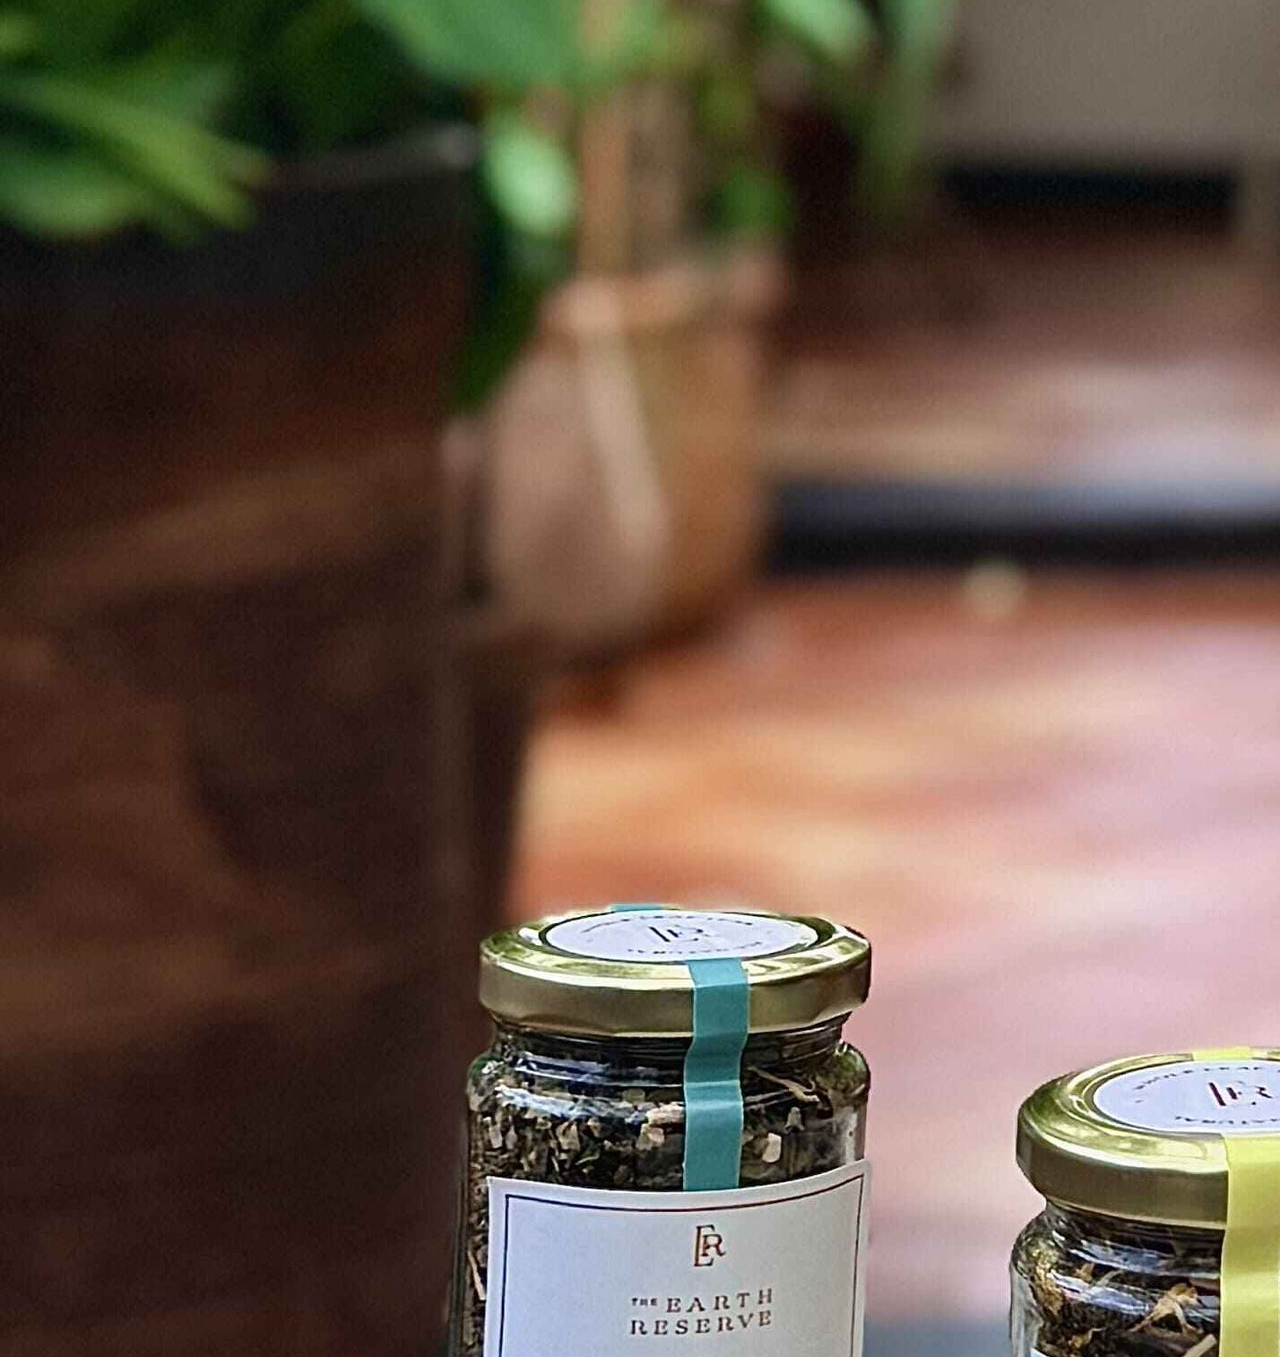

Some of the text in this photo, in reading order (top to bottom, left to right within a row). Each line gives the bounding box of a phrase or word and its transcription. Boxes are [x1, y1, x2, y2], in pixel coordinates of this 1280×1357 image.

[631, 1287, 773, 1313] THE EARTH
[630, 1309, 773, 1336] RESERVE
